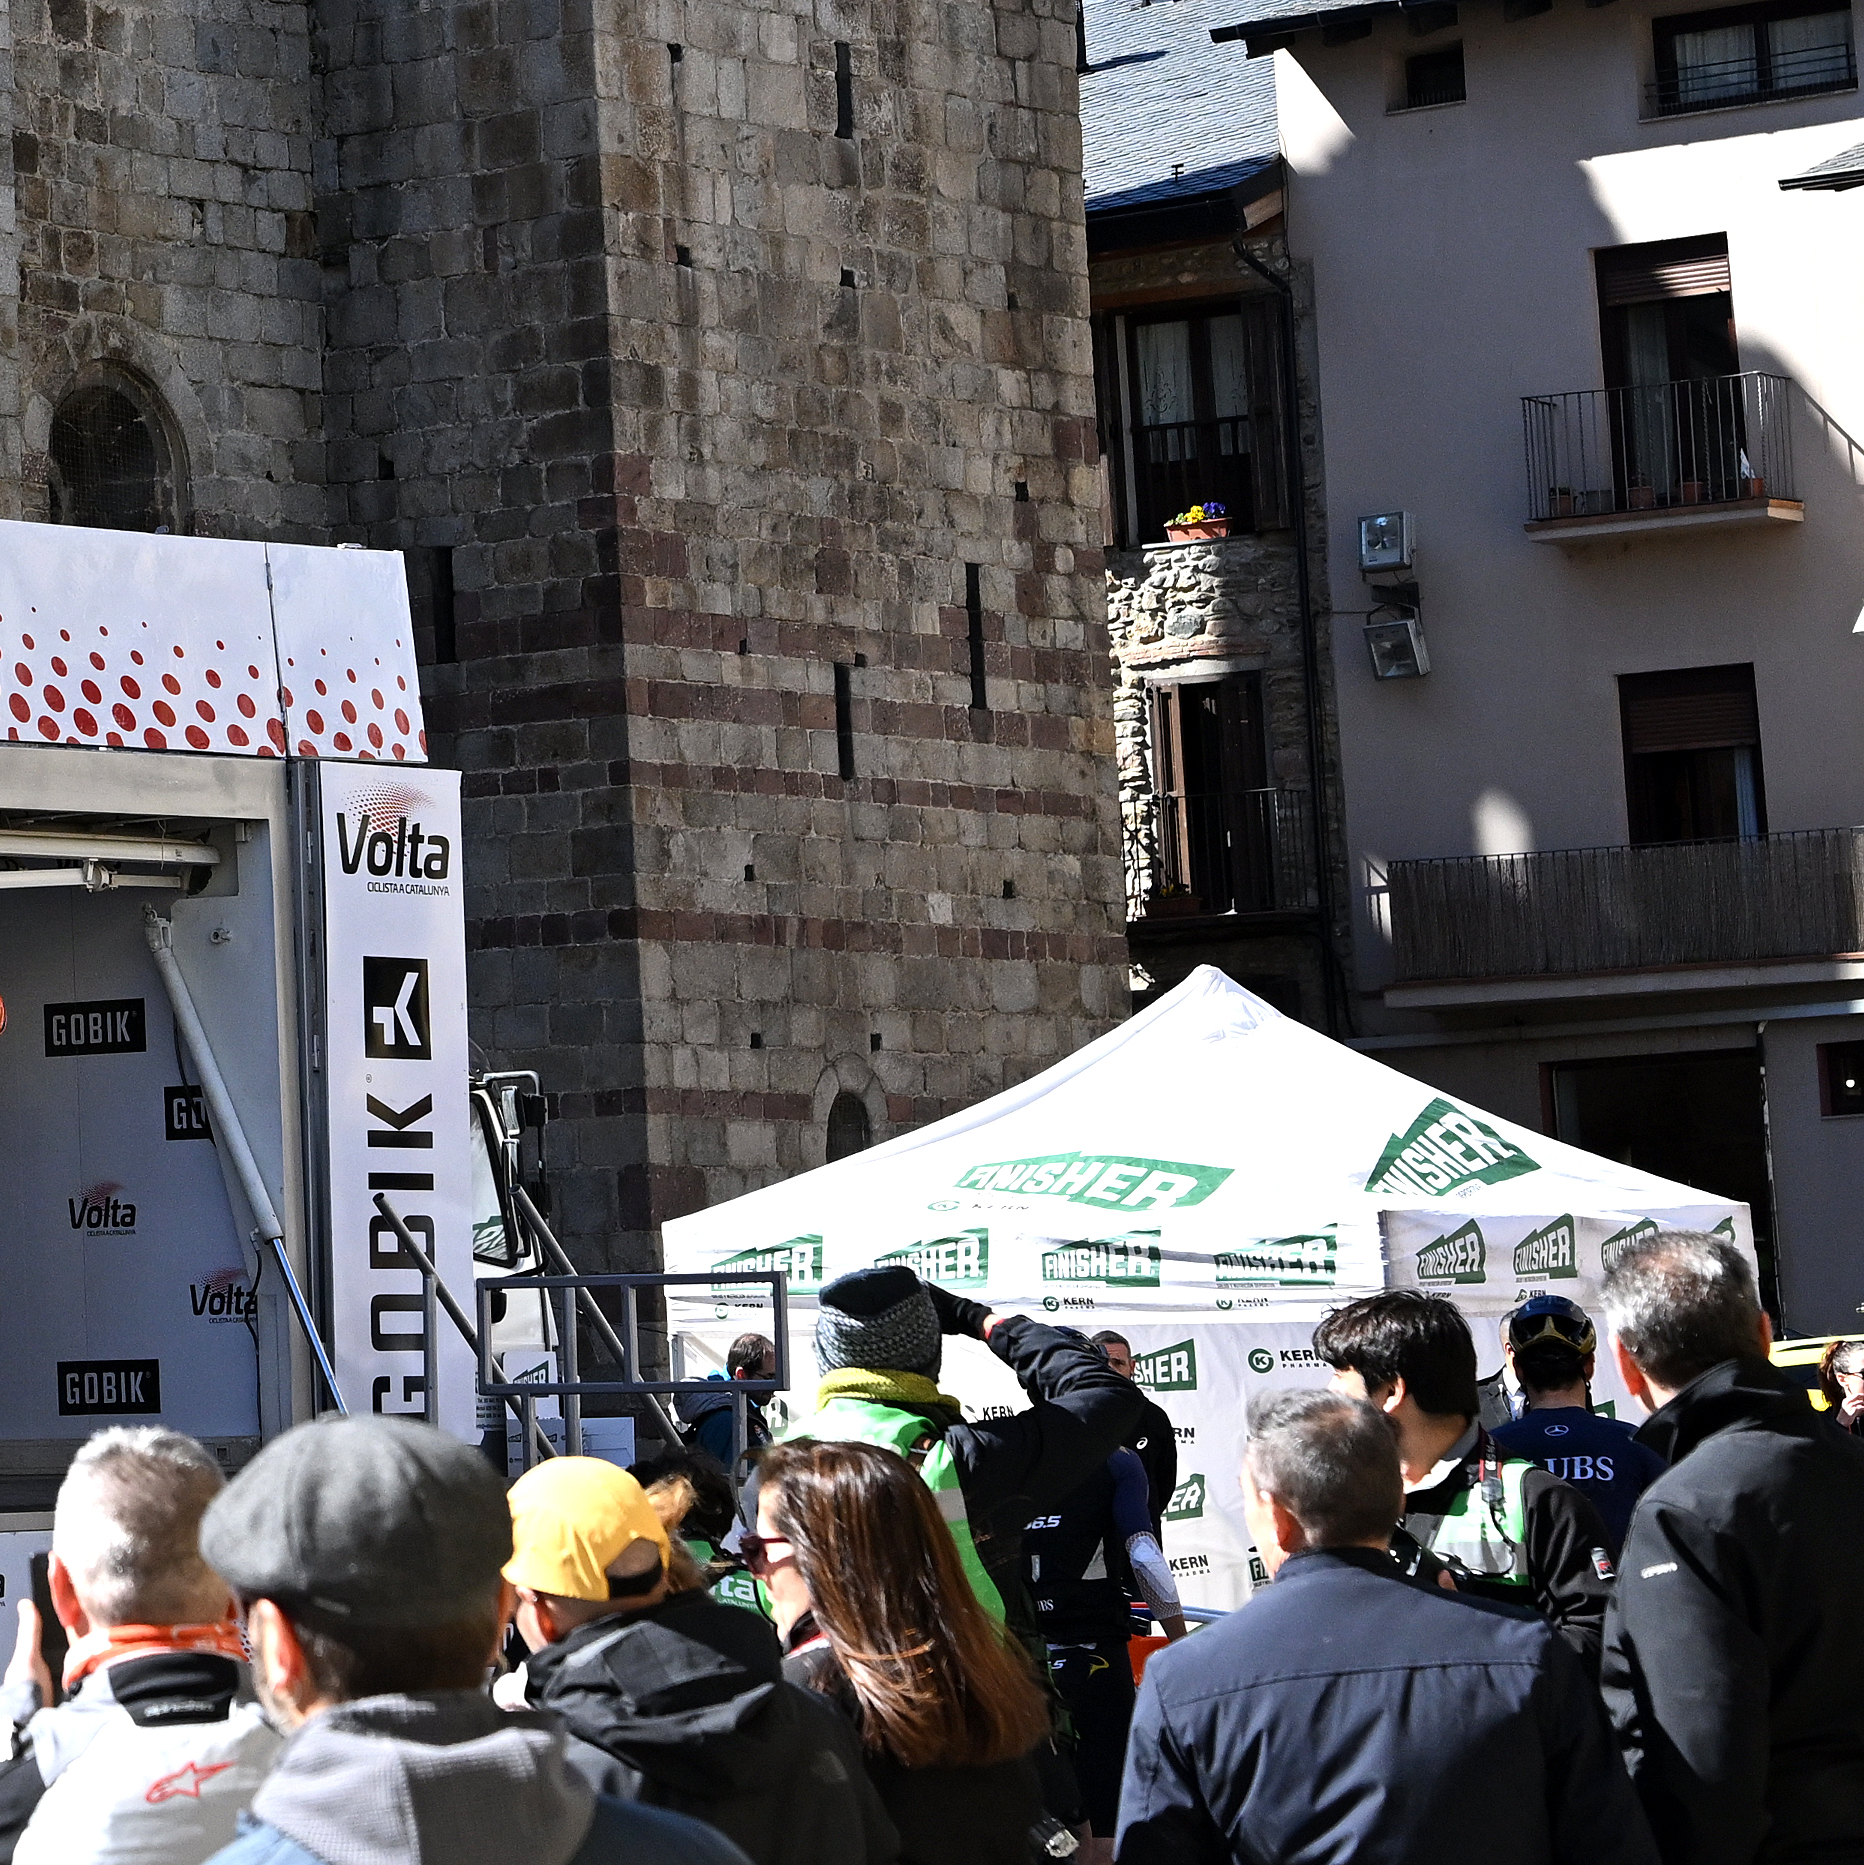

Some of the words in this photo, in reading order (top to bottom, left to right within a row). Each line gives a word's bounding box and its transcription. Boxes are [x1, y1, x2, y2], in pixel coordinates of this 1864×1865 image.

[337, 813, 450, 879] Volta
[367, 882, 398, 893] CICLISTA
[405, 884, 450, 896] CATALUNYA
[52, 1011, 130, 1045] GOBIK
[961, 1161, 1198, 1208] FINISHER
[69, 1197, 136, 1229] Volta
[1045, 1238, 1152, 1278] FINISHER
[1419, 1232, 1480, 1276] FINISHER
[1515, 1226, 1570, 1272] FINISHER
[190, 1283, 258, 1317] Volta
[1063, 1297, 1094, 1305] KERN
[1134, 1351, 1189, 1383] SHER
[66, 1371, 145, 1406] GOBIK
[982, 1406, 1014, 1420] KERN
[1544, 1456, 1614, 1481] UBS
[1170, 1555, 1208, 1571] KERN
